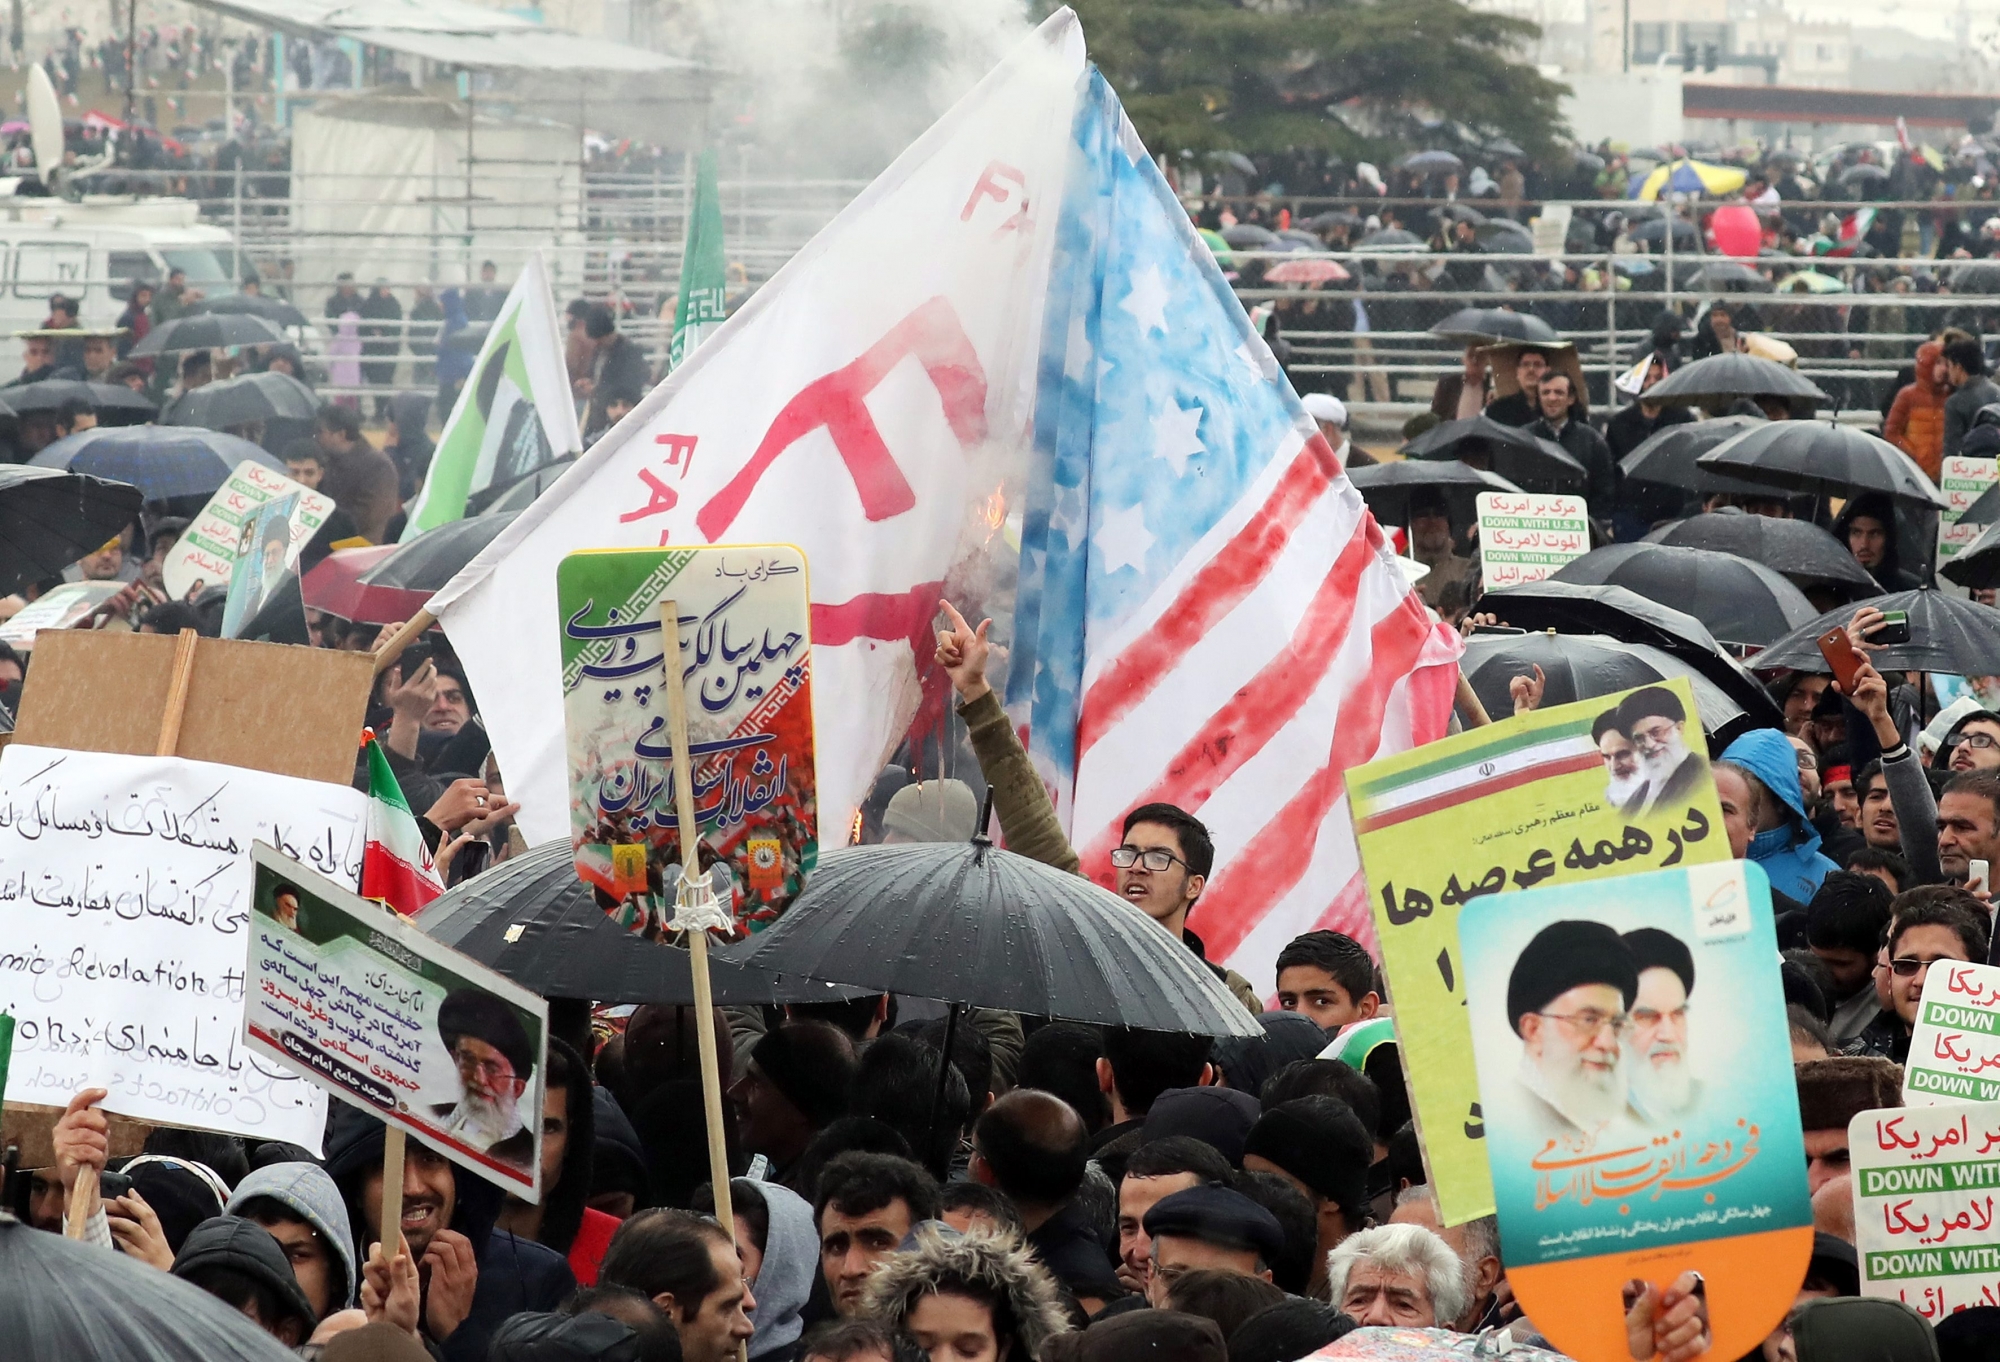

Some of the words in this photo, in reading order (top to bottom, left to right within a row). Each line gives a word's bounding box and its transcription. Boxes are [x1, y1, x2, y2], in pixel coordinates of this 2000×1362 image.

[58, 262, 79, 279] TV
[1947, 481, 1977, 491] DOWN
[1489, 497, 1530, 514] امریکا
[1533, 504, 1546, 516] بر
[1550, 499, 1577, 516] مرگ
[1485, 517, 1519, 527] DOWN
[1521, 519, 1550, 529] WITH
[1553, 520, 1582, 530] U.S.A
[1543, 534, 1581, 552] الموت
[1487, 551, 1519, 561] DOWN
[1521, 553, 1548, 563] WITH
[715, 557, 748, 583] باد
[750, 558, 800, 582] گرامی
[1549, 807, 1577, 826] معظم
[1578, 801, 1602, 819] مقام
[1513, 817, 1548, 836] رهبری
[1660, 807, 1711, 868] در
[1563, 823, 1653, 871] همه
[1381, 879, 1434, 927] ها
[260, 933, 283, 953] که
[283, 949, 318, 975] است
[299, 978, 327, 1003] چهل
[317, 973, 340, 988] این
[340, 985, 372, 1007] مهم
[328, 998, 365, 1024] چالش
[373, 1002, 422, 1031] حقیقت
[1929, 1005, 1995, 1031] DOWN
[294, 1016, 318, 1039] بوده
[335, 1021, 374, 1049] مغلوب
[366, 1018, 380, 1033] در
[380, 1021, 422, 1052] آمریکا
[283, 1036, 311, 1059] سجاد
[319, 1036, 369, 1065] اسلامی
[311, 1053, 332, 1070] امام
[333, 1066, 360, 1088] جامع
[370, 1063, 420, 1092] جمهوری
[1913, 1071, 1974, 1096] DOWN
[361, 1083, 394, 1105] مسجد
[1876, 1114, 1969, 1160] امریکا
[1867, 1167, 1944, 1193] DOWN
[1883, 1195, 1994, 1245] لامریکا
[1872, 1252, 1943, 1276] DOWN
